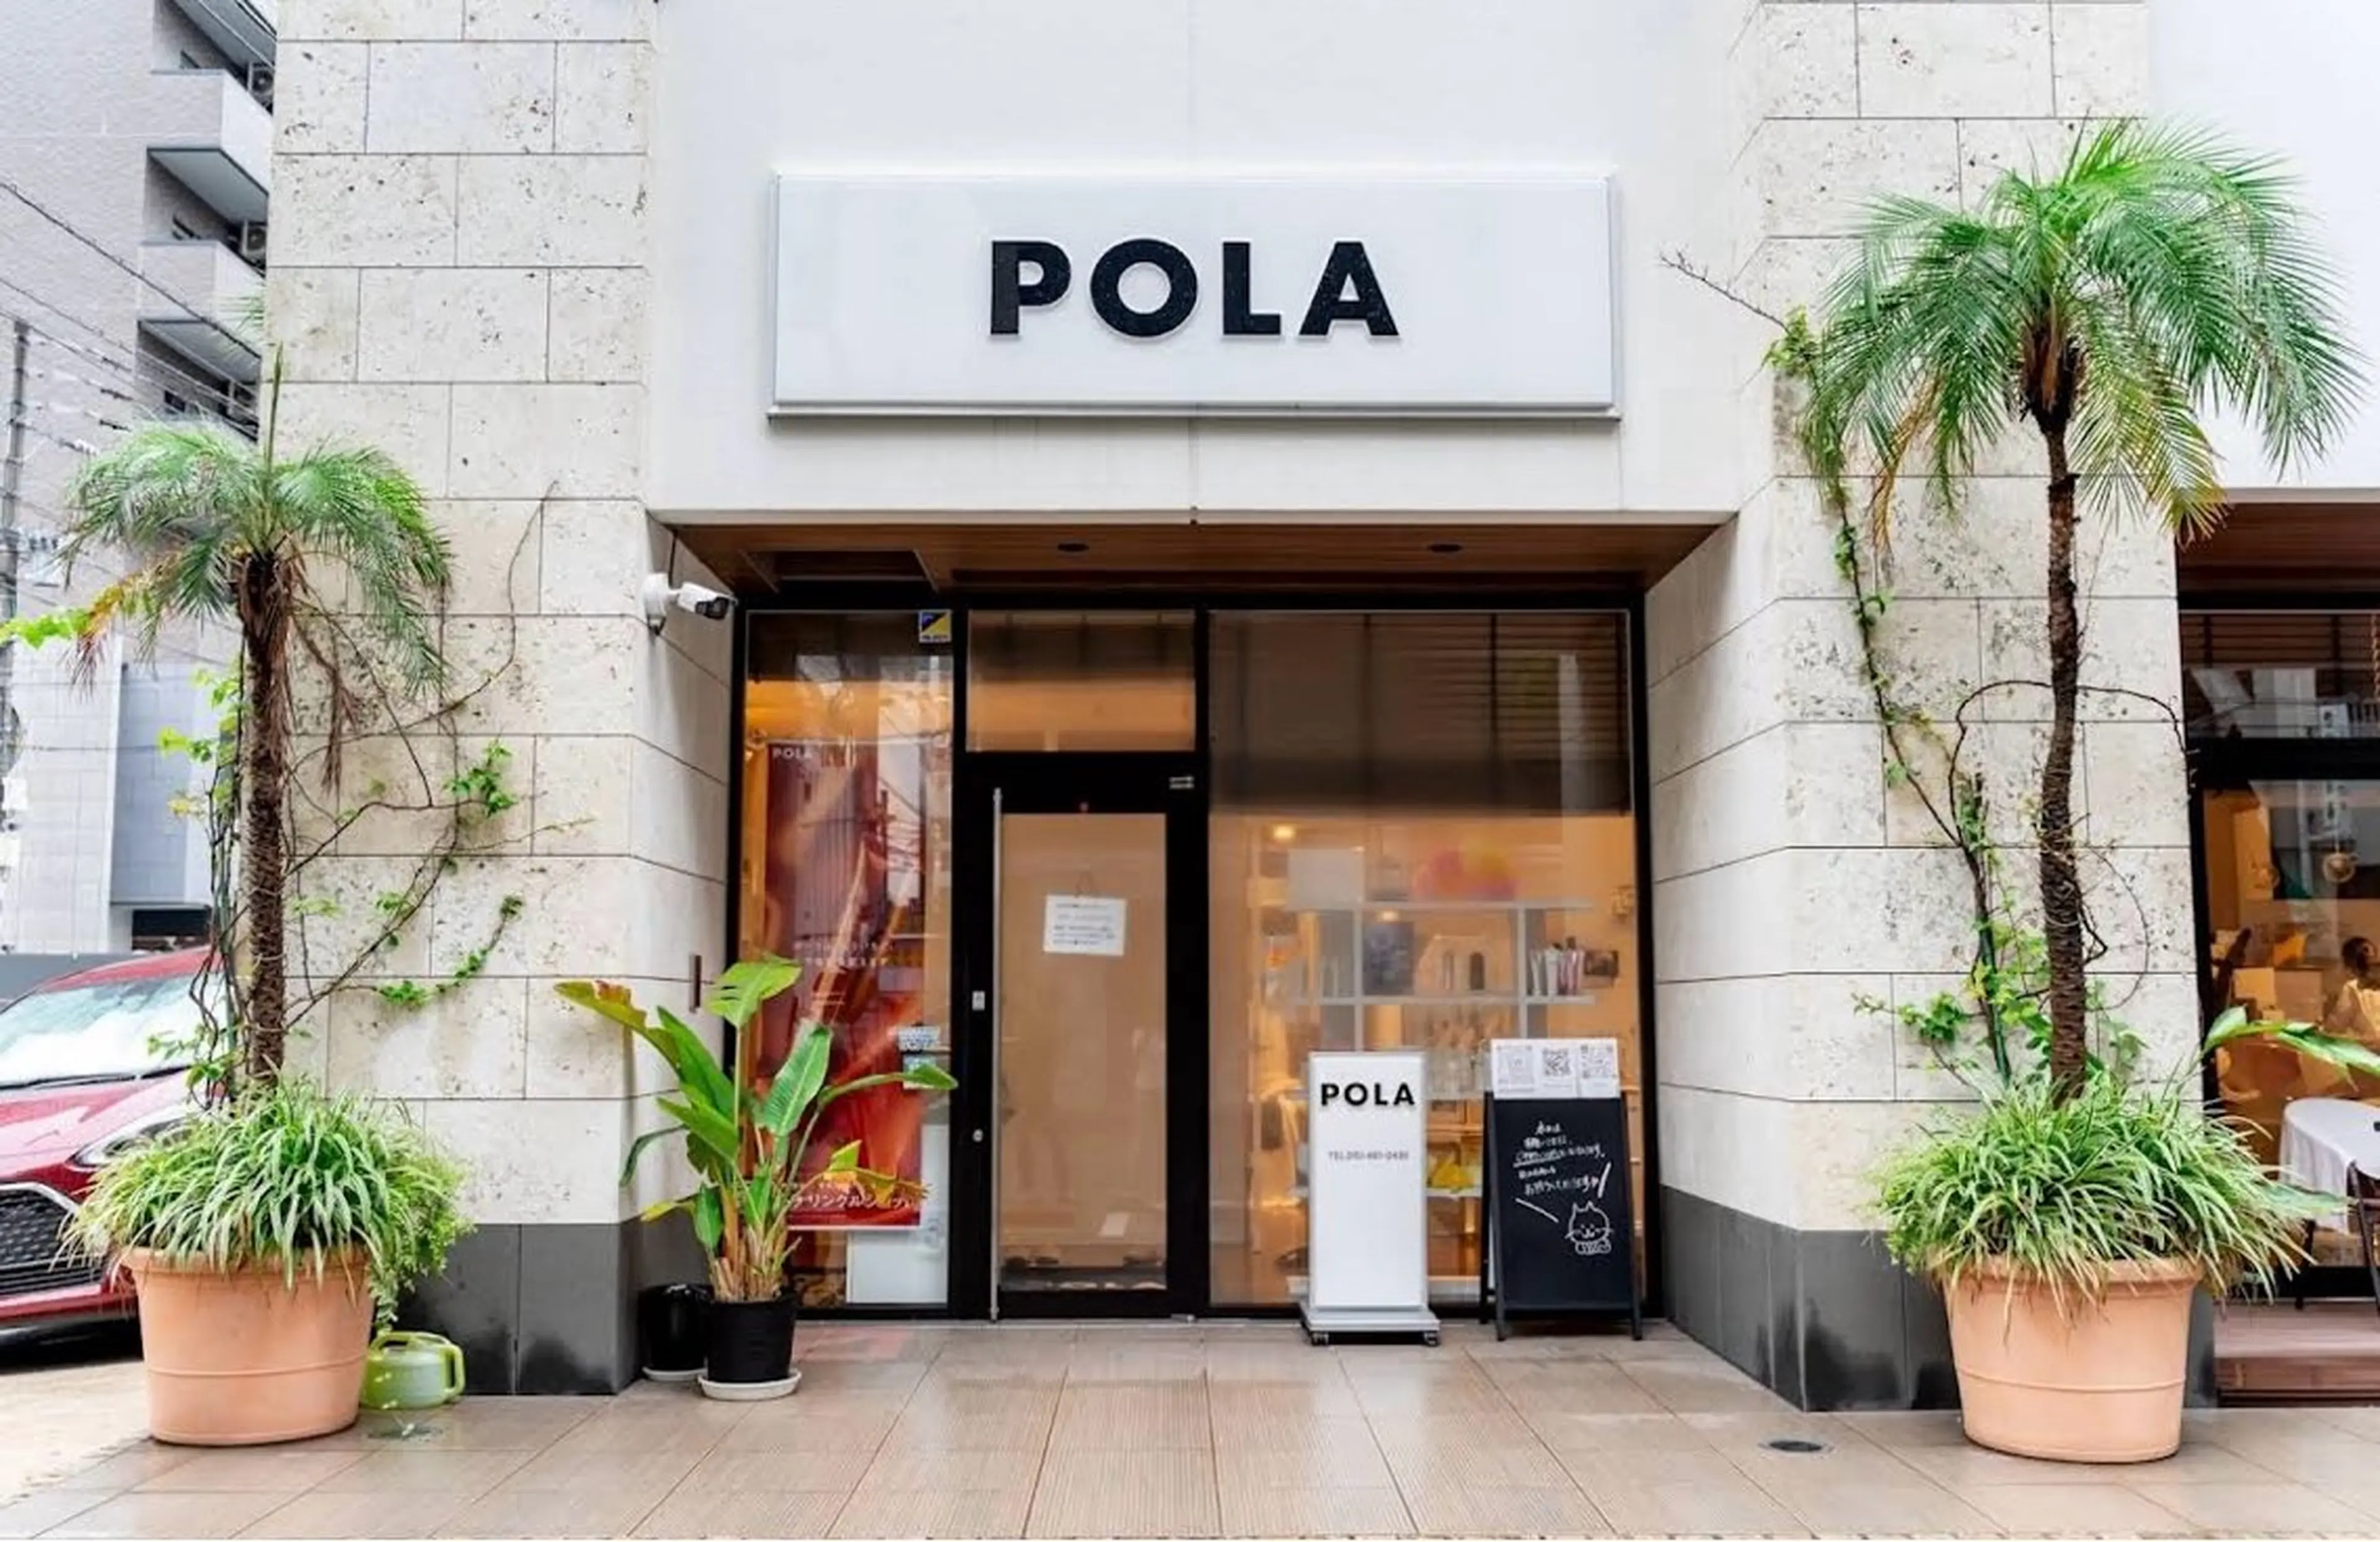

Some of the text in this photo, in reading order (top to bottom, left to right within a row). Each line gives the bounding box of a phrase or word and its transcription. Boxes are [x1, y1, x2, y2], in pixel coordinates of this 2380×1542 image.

[990, 238, 1399, 337] POLA
[772, 747, 813, 760] POLA
[1321, 1082, 1415, 1106] POLA
